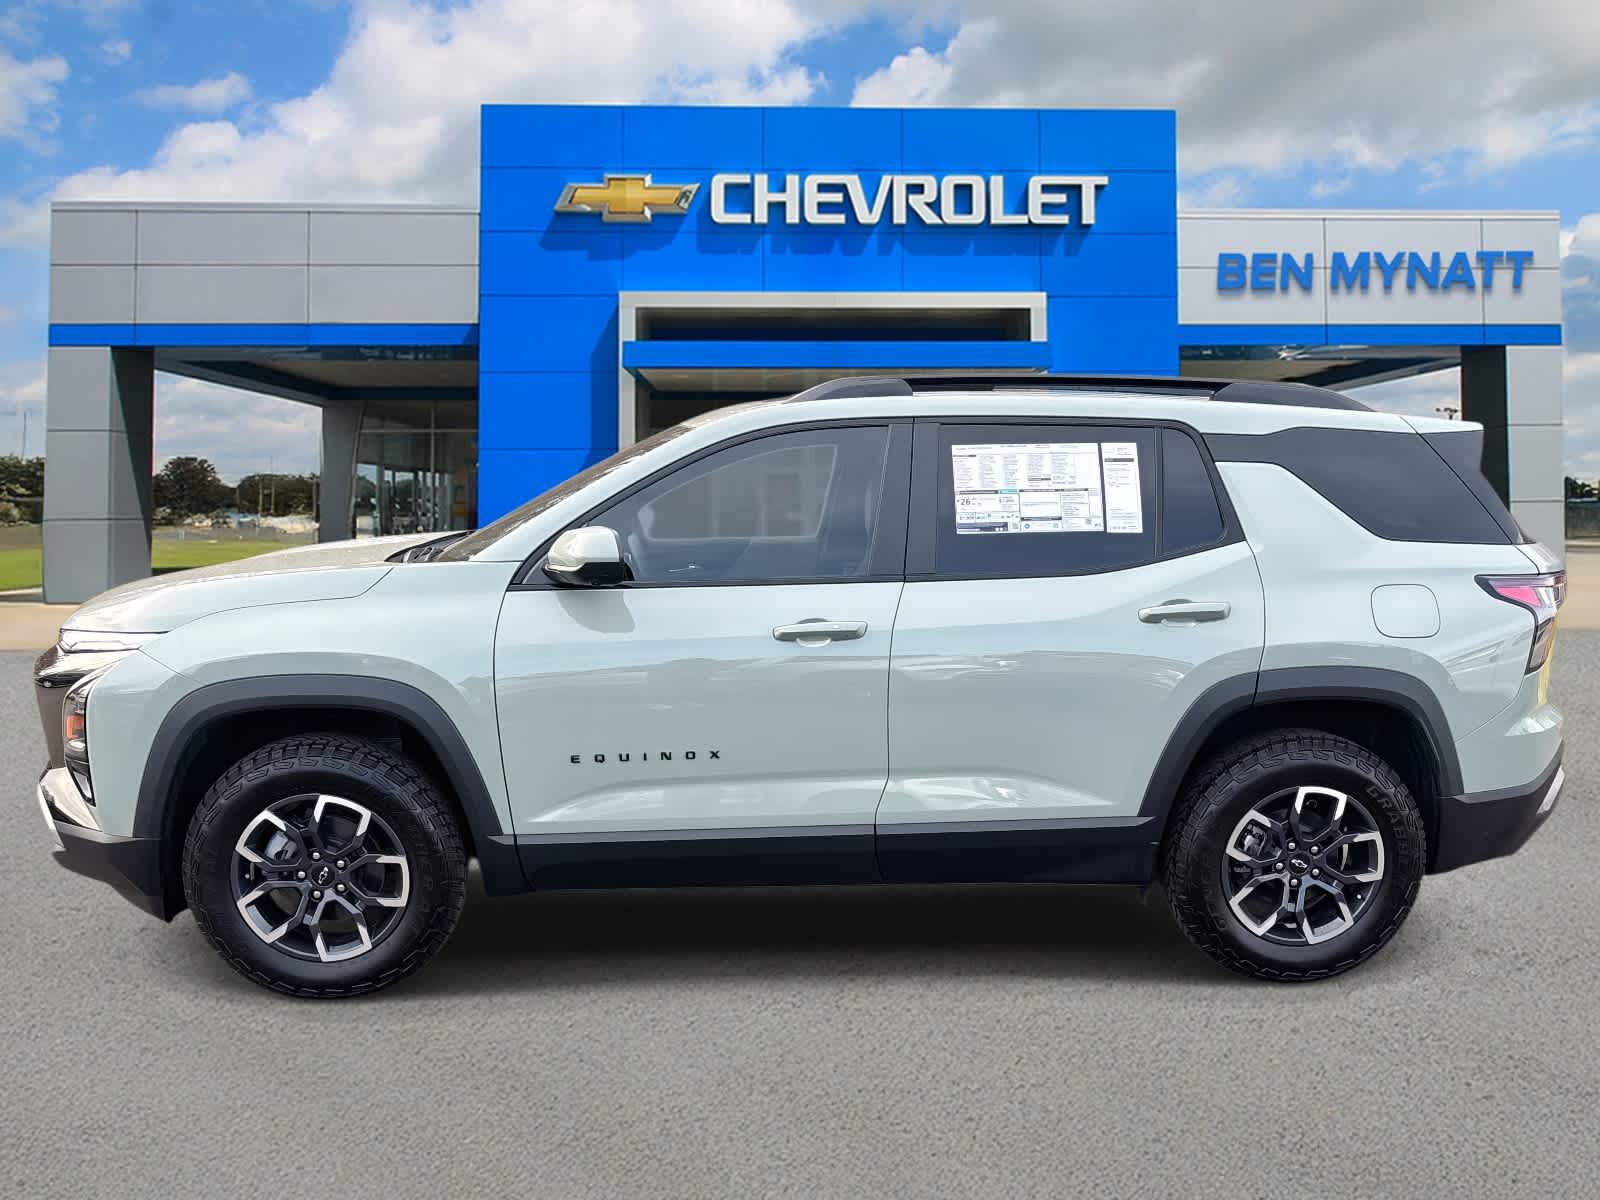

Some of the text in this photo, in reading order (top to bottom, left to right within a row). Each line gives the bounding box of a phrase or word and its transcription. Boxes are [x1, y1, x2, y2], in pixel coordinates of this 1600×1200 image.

[711, 173, 1109, 225] CHEVROLET
[1217, 250, 1534, 290] BEN MYNATT
[570, 750, 720, 764] EQUINOX
